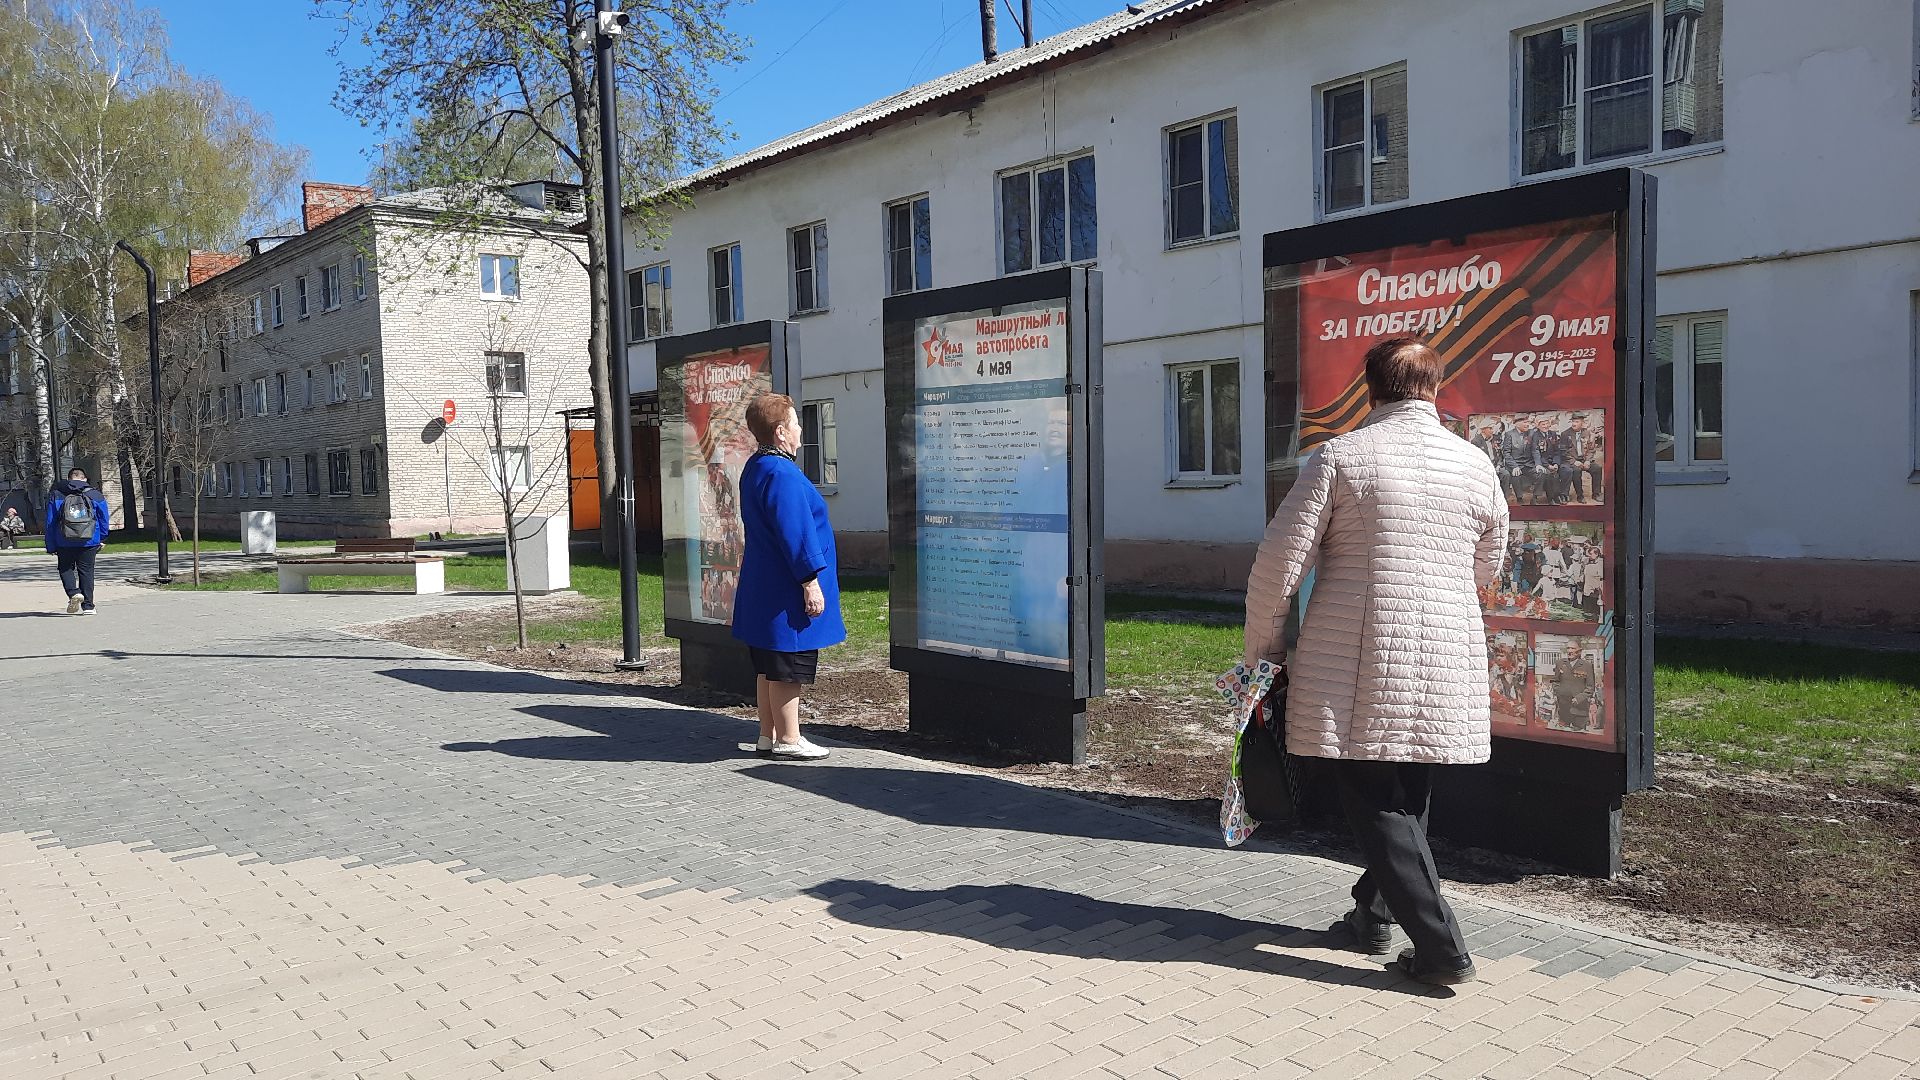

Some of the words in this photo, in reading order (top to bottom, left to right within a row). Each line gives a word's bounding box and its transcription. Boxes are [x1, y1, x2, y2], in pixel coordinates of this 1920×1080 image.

[1357, 254, 1502, 306] Спасибо
[975, 308, 1051, 337] Маршрутный
[1319, 319, 1348, 341] ЗА
[1354, 304, 1464, 338] ПОБЕДУ!
[1529, 314, 1555, 347] 9
[1557, 315, 1611, 339] МАЯ
[976, 333, 1049, 355] автопробега
[704, 359, 751, 384] Спасибо
[976, 360, 984, 377] 4
[989, 360, 1012, 377] мая
